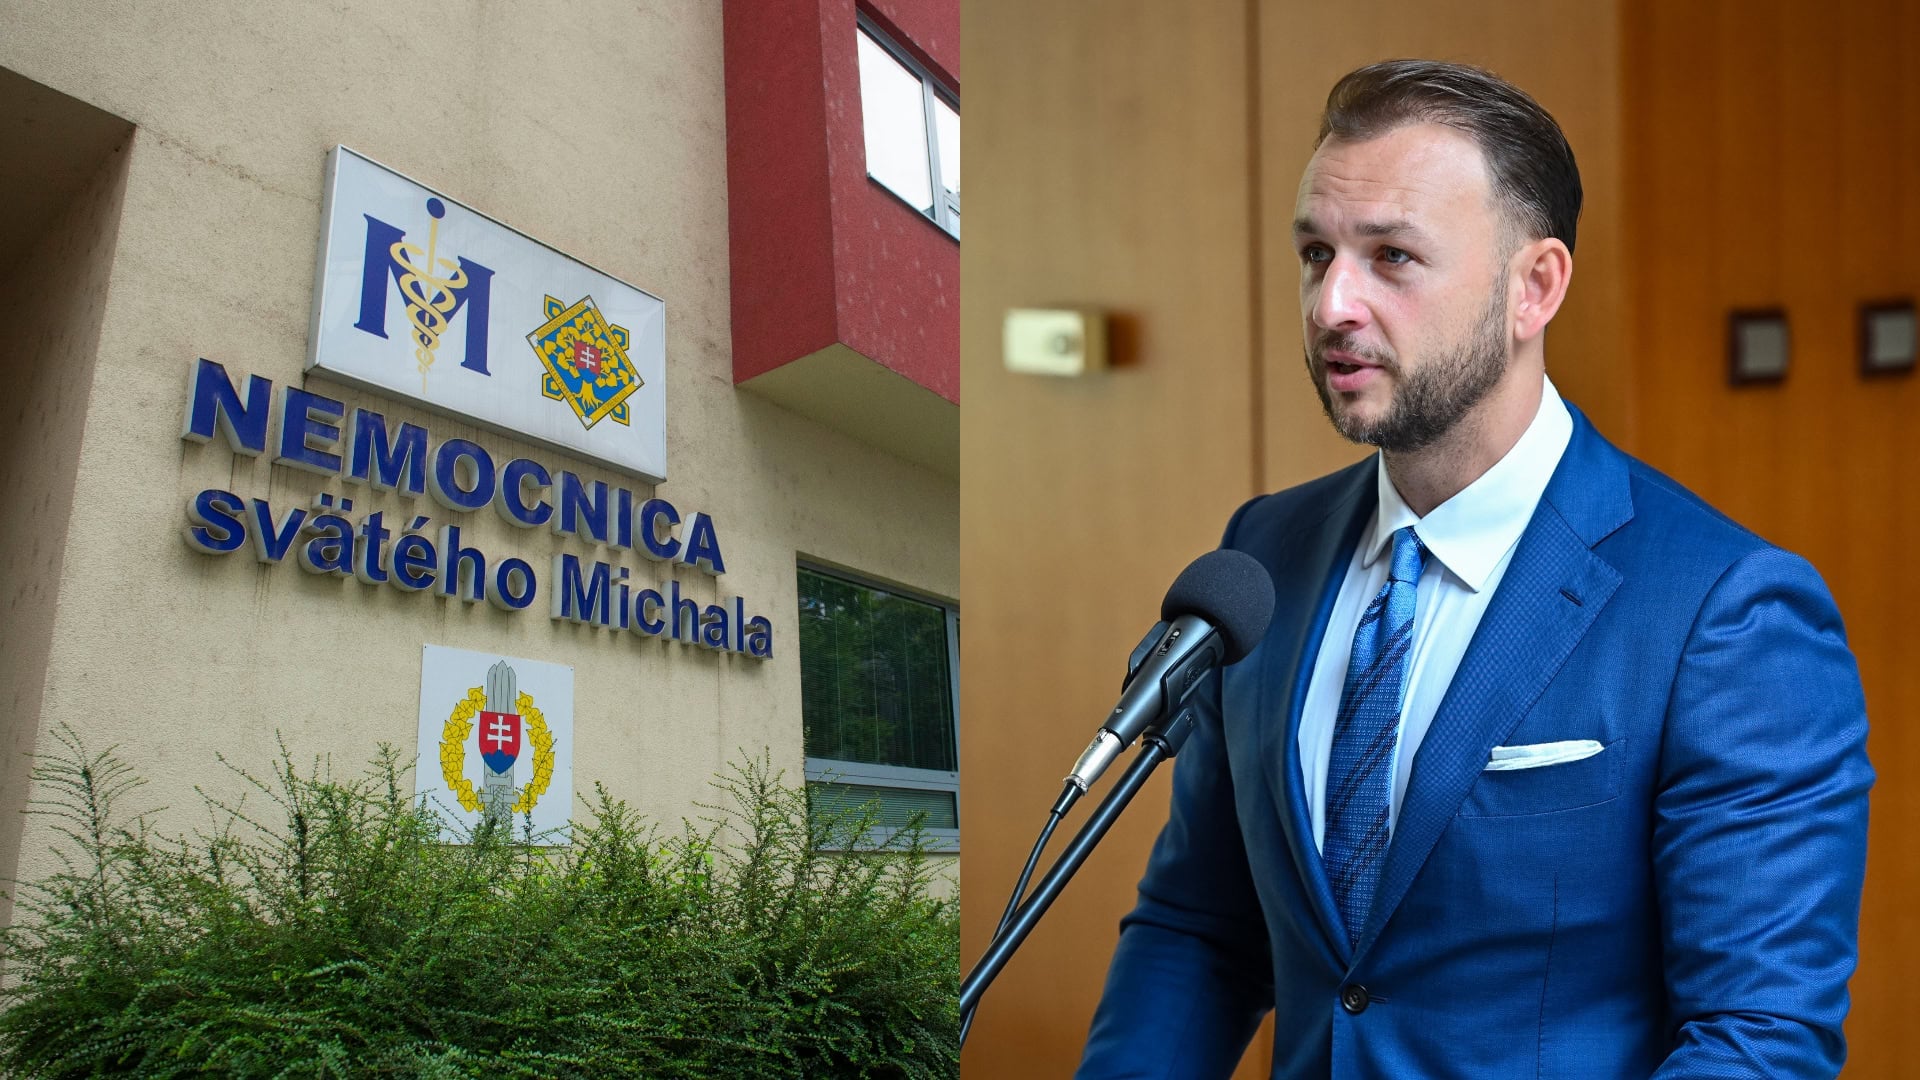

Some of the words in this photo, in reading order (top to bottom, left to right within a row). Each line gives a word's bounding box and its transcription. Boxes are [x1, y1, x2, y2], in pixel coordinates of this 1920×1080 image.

[184, 358, 726, 575] NEMOCNICA
[187, 488, 538, 611] svätého
[553, 553, 773, 658] Michala
